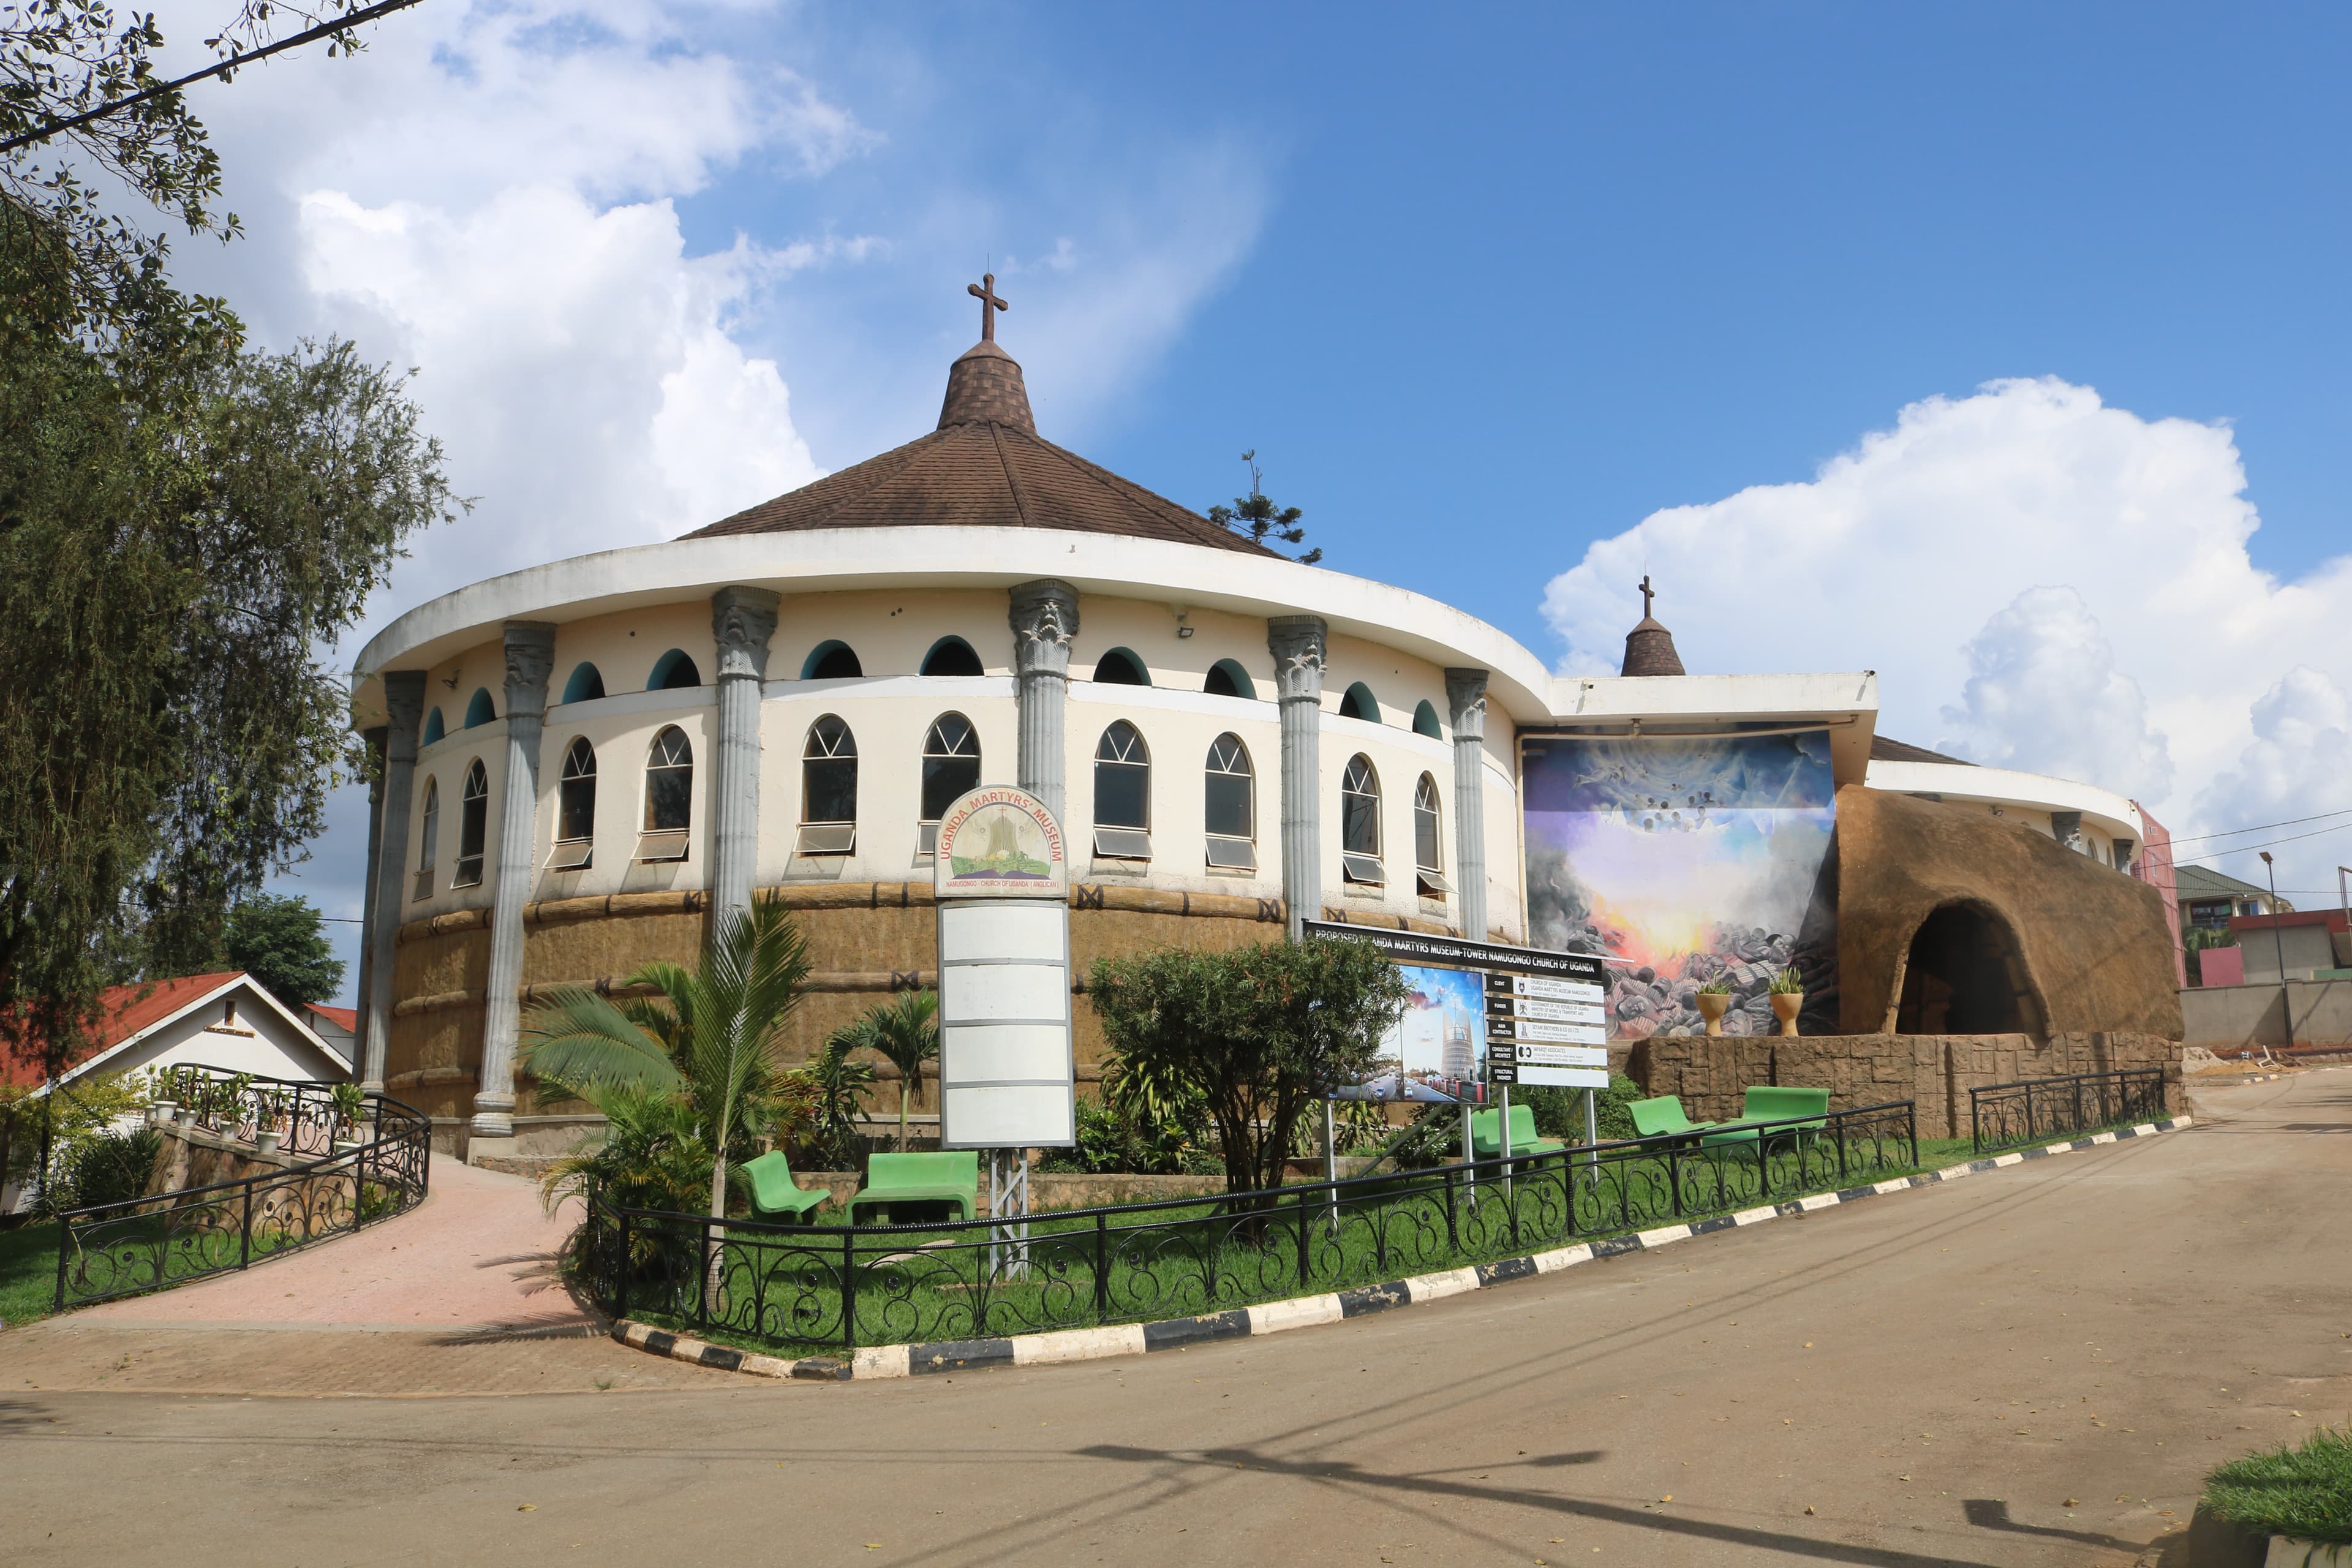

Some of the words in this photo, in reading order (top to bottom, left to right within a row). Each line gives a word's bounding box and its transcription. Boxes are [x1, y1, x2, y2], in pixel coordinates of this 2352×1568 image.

[941, 809, 968, 860] UGANDA
[1033, 809, 1061, 861] MUSEUM
[1394, 939, 1429, 953] MARTYRS
[1430, 944, 1487, 960] MUSEUM-TOWER
[1488, 951, 1531, 966] NAMUGONGO
[1532, 959, 1558, 969] CHURCH
[1559, 960, 1568, 970] OF
[1570, 962, 1594, 973] UGANDA
